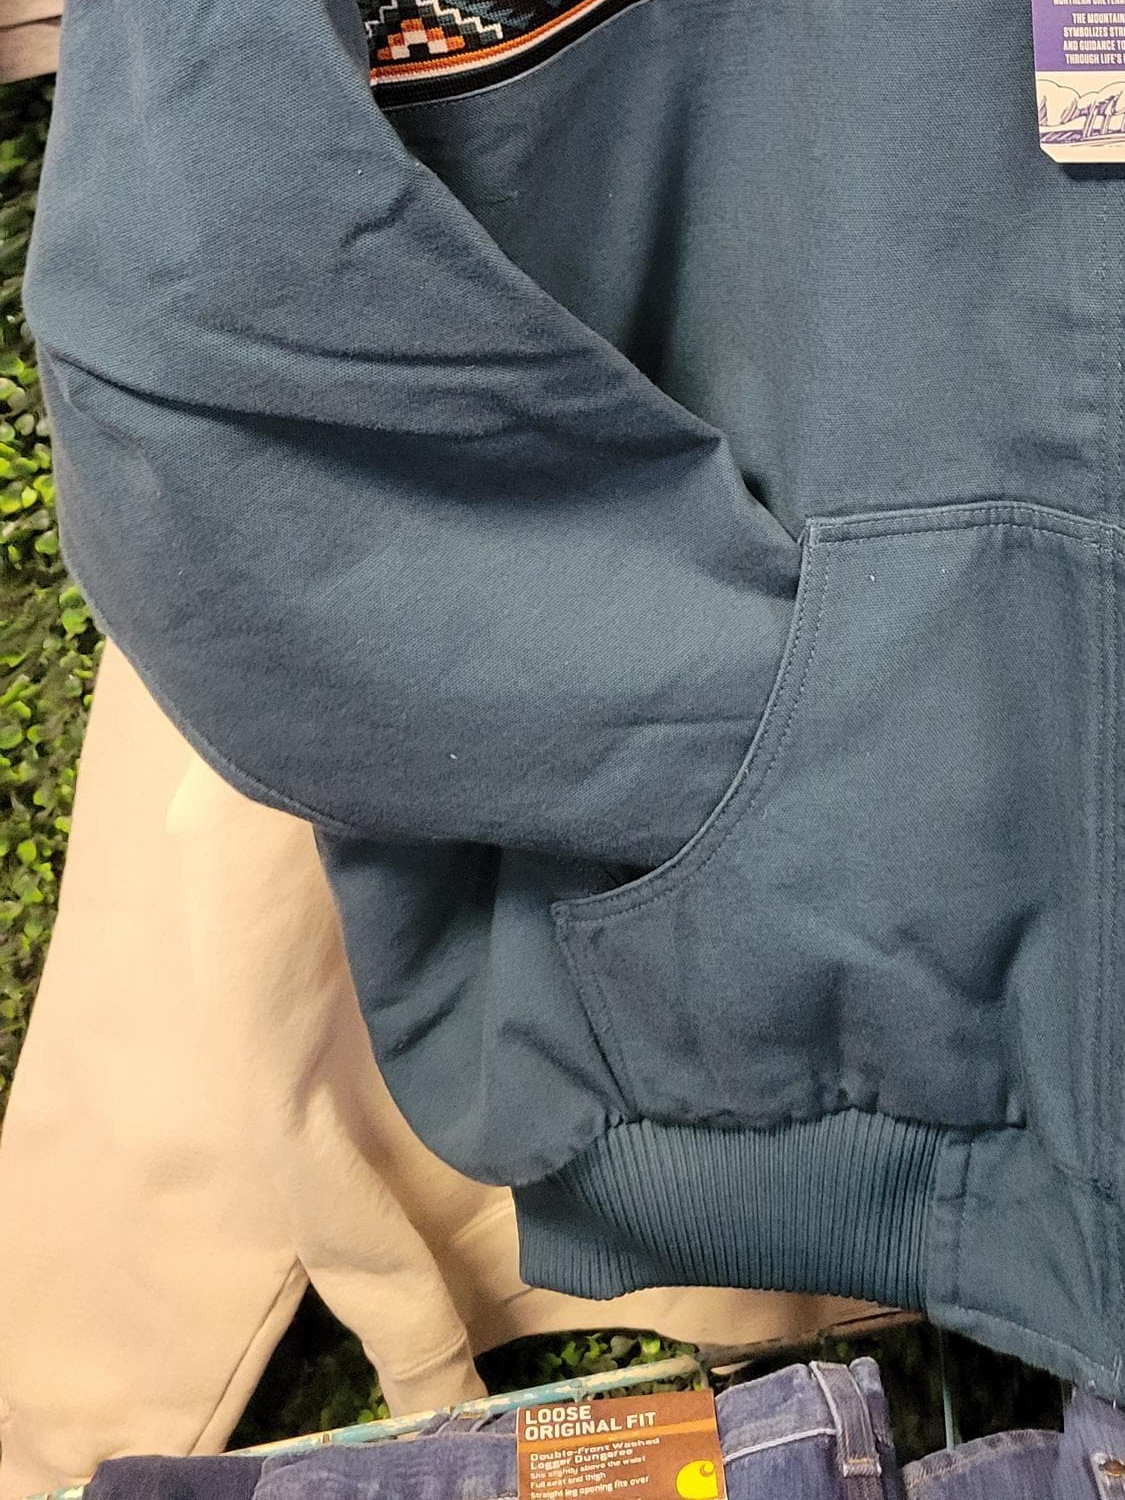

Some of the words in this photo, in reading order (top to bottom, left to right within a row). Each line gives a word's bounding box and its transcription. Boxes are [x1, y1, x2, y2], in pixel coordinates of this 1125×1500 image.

[1072, 13, 1086, 23] THE
[1087, 13, 1125, 23] MOUNTAIN
[1063, 27, 1108, 37] SYMBOLIZES
[1063, 40, 1078, 50] AND
[1080, 40, 1115, 50] GUIDANCE
[1117, 40, 1125, 50] TO
[1065, 54, 1099, 64] THROUGH
[1101, 53, 1122, 64] LIFE'S
[524, 1405, 592, 1425] LOOSE
[524, 1418, 622, 1442] ORIGINAL
[626, 1412, 657, 1429] FIT
[530, 1444, 610, 1462] Double-Front
[612, 1437, 660, 1450] Washed
[530, 1458, 571, 1471] Logger
[574, 1449, 634, 1464] Dungaree
[607, 1460, 621, 1468] the
[568, 1475, 583, 1484] and
[630, 1475, 649, 1486] over
